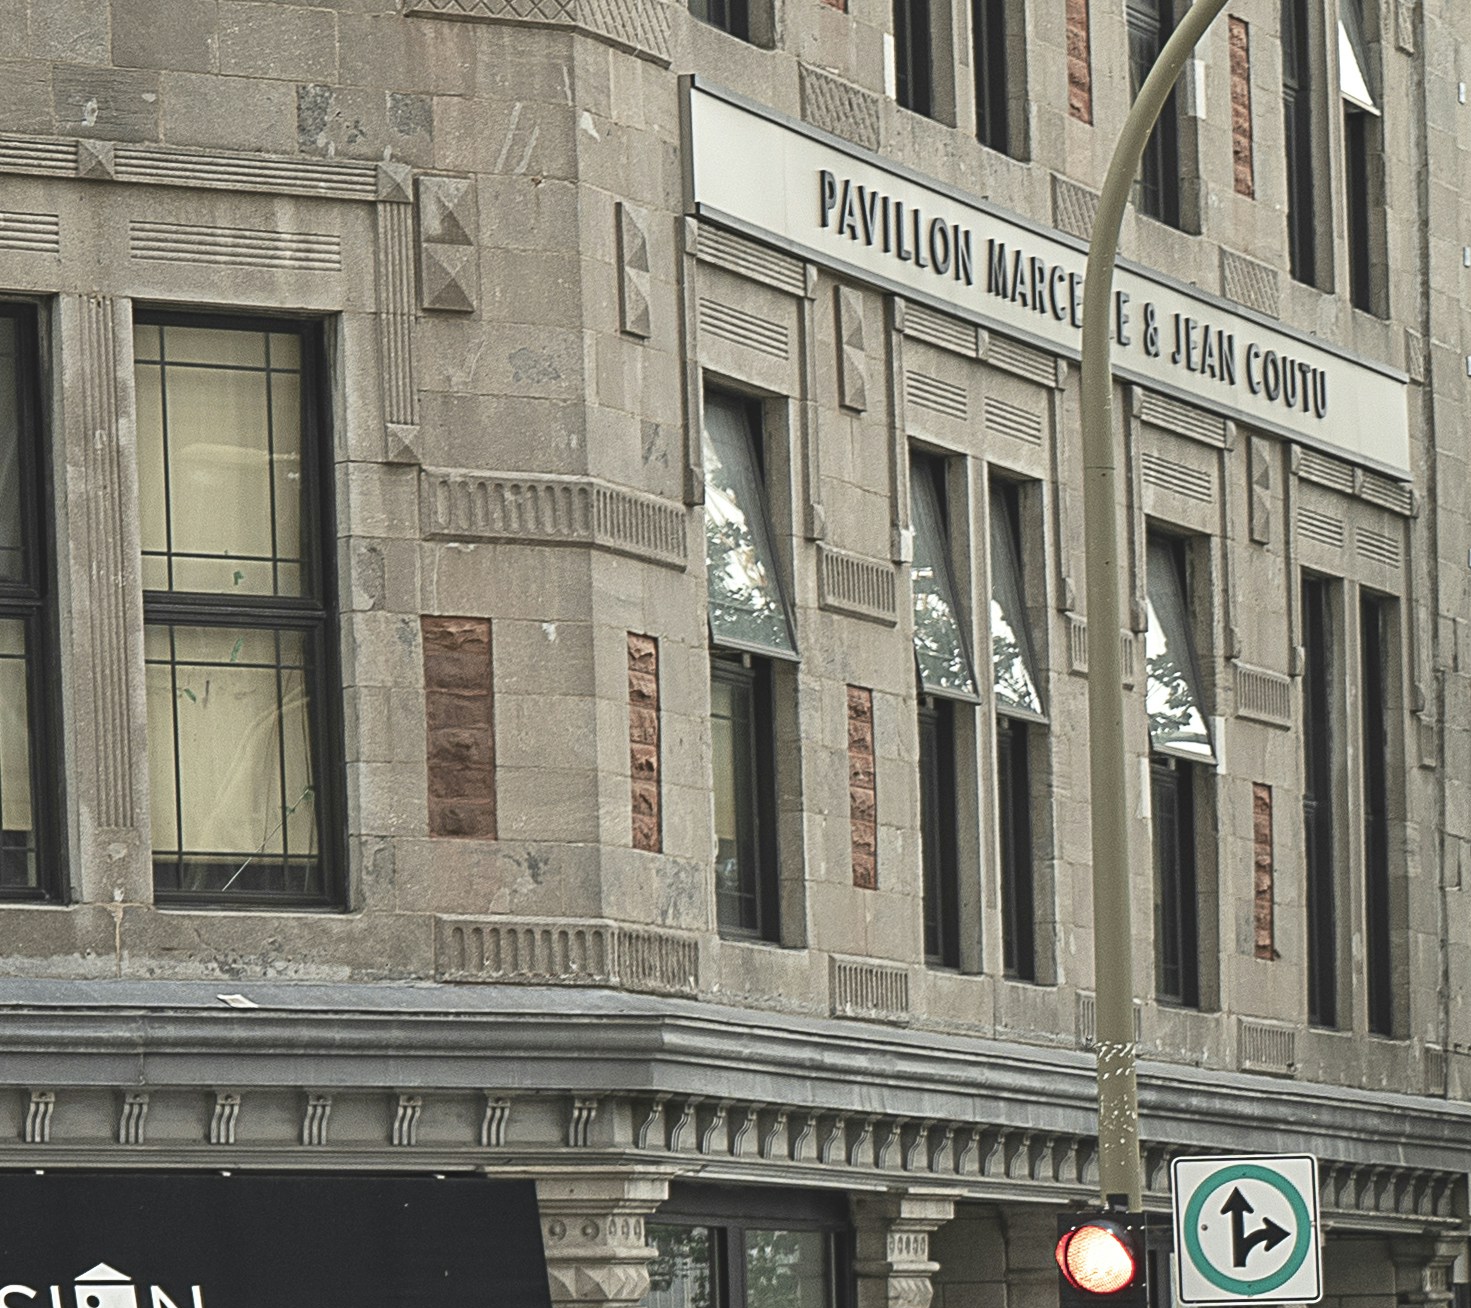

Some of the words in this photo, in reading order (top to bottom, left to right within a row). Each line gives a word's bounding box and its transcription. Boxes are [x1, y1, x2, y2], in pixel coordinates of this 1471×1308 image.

[818, 167, 974, 287] PAVILLON
[1144, 302, 1160, 357] &
[1172, 312, 1236, 386] JEAN
[1246, 342, 1328, 418] COUTU
